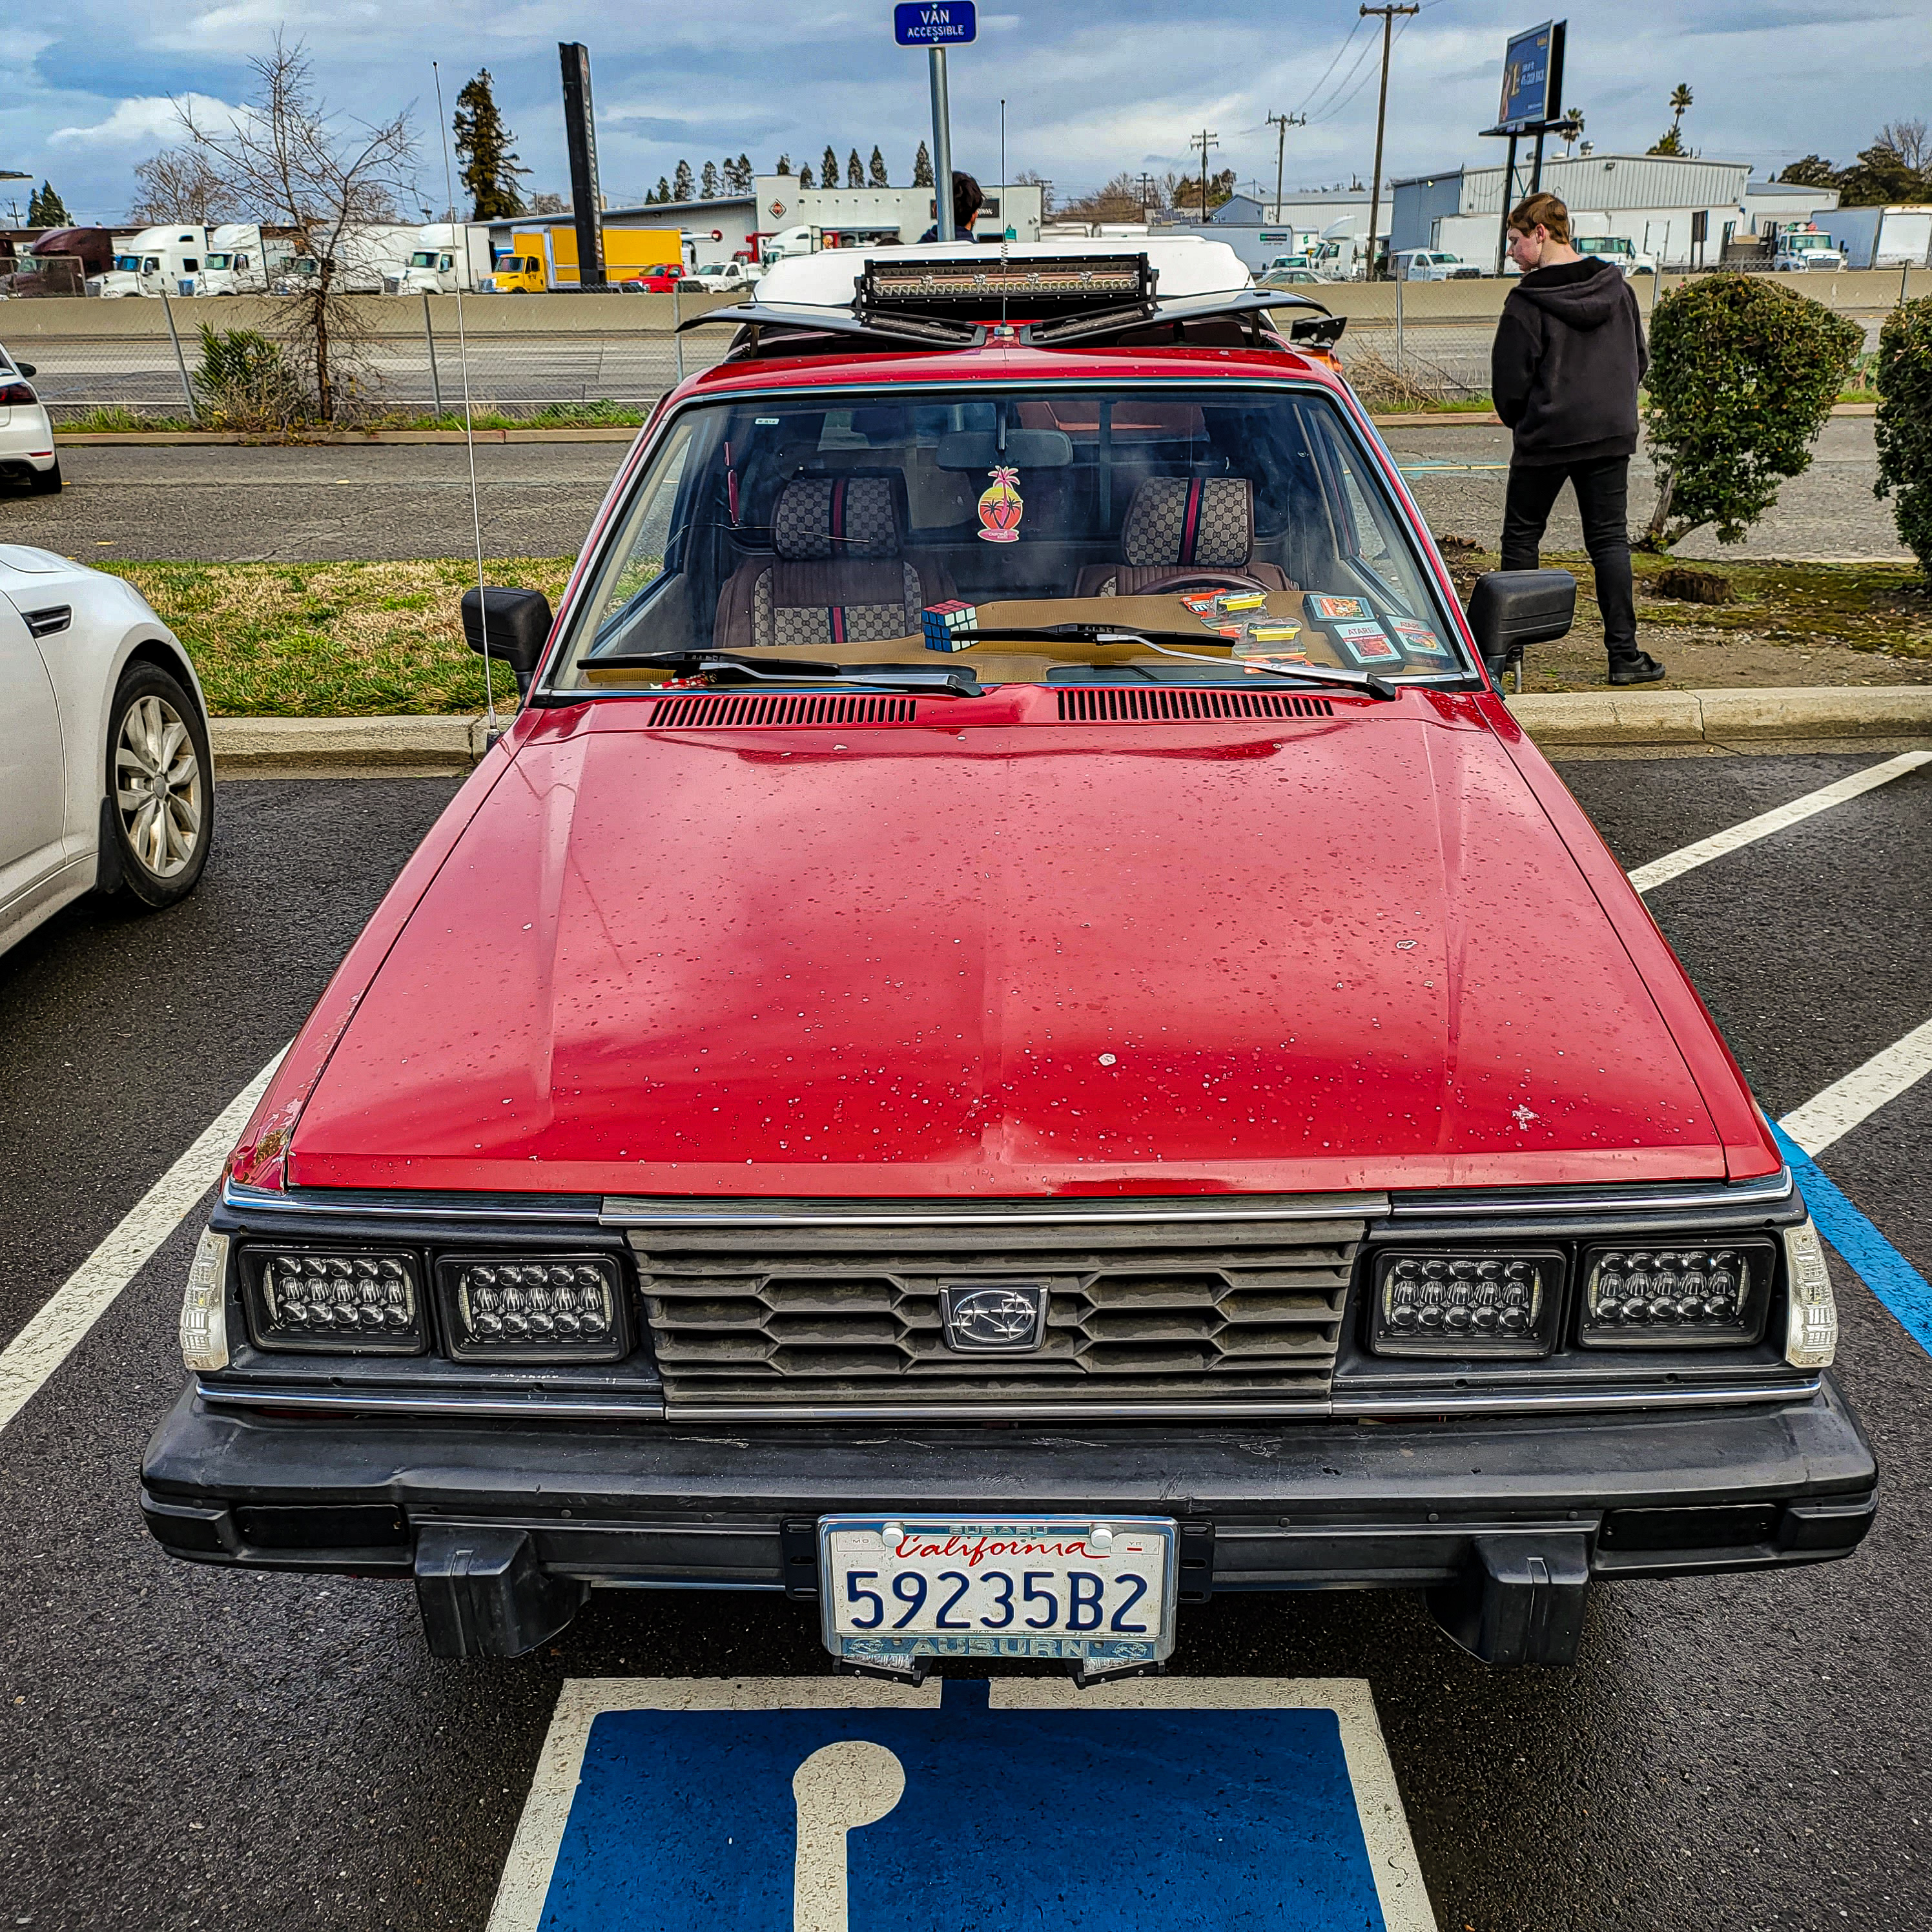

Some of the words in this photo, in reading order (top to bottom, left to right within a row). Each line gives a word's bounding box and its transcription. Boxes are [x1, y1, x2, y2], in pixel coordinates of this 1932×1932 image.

[920, 10, 949, 25] VAN
[907, 25, 964, 38] ACCESSIBLE
[1348, 626, 1374, 635] ATARI
[949, 1526, 1048, 1536] SUBARU
[896, 1535, 1111, 1567] California
[846, 1570, 1148, 1633] 59235B2
[909, 1637, 1090, 1658] AUBURN
